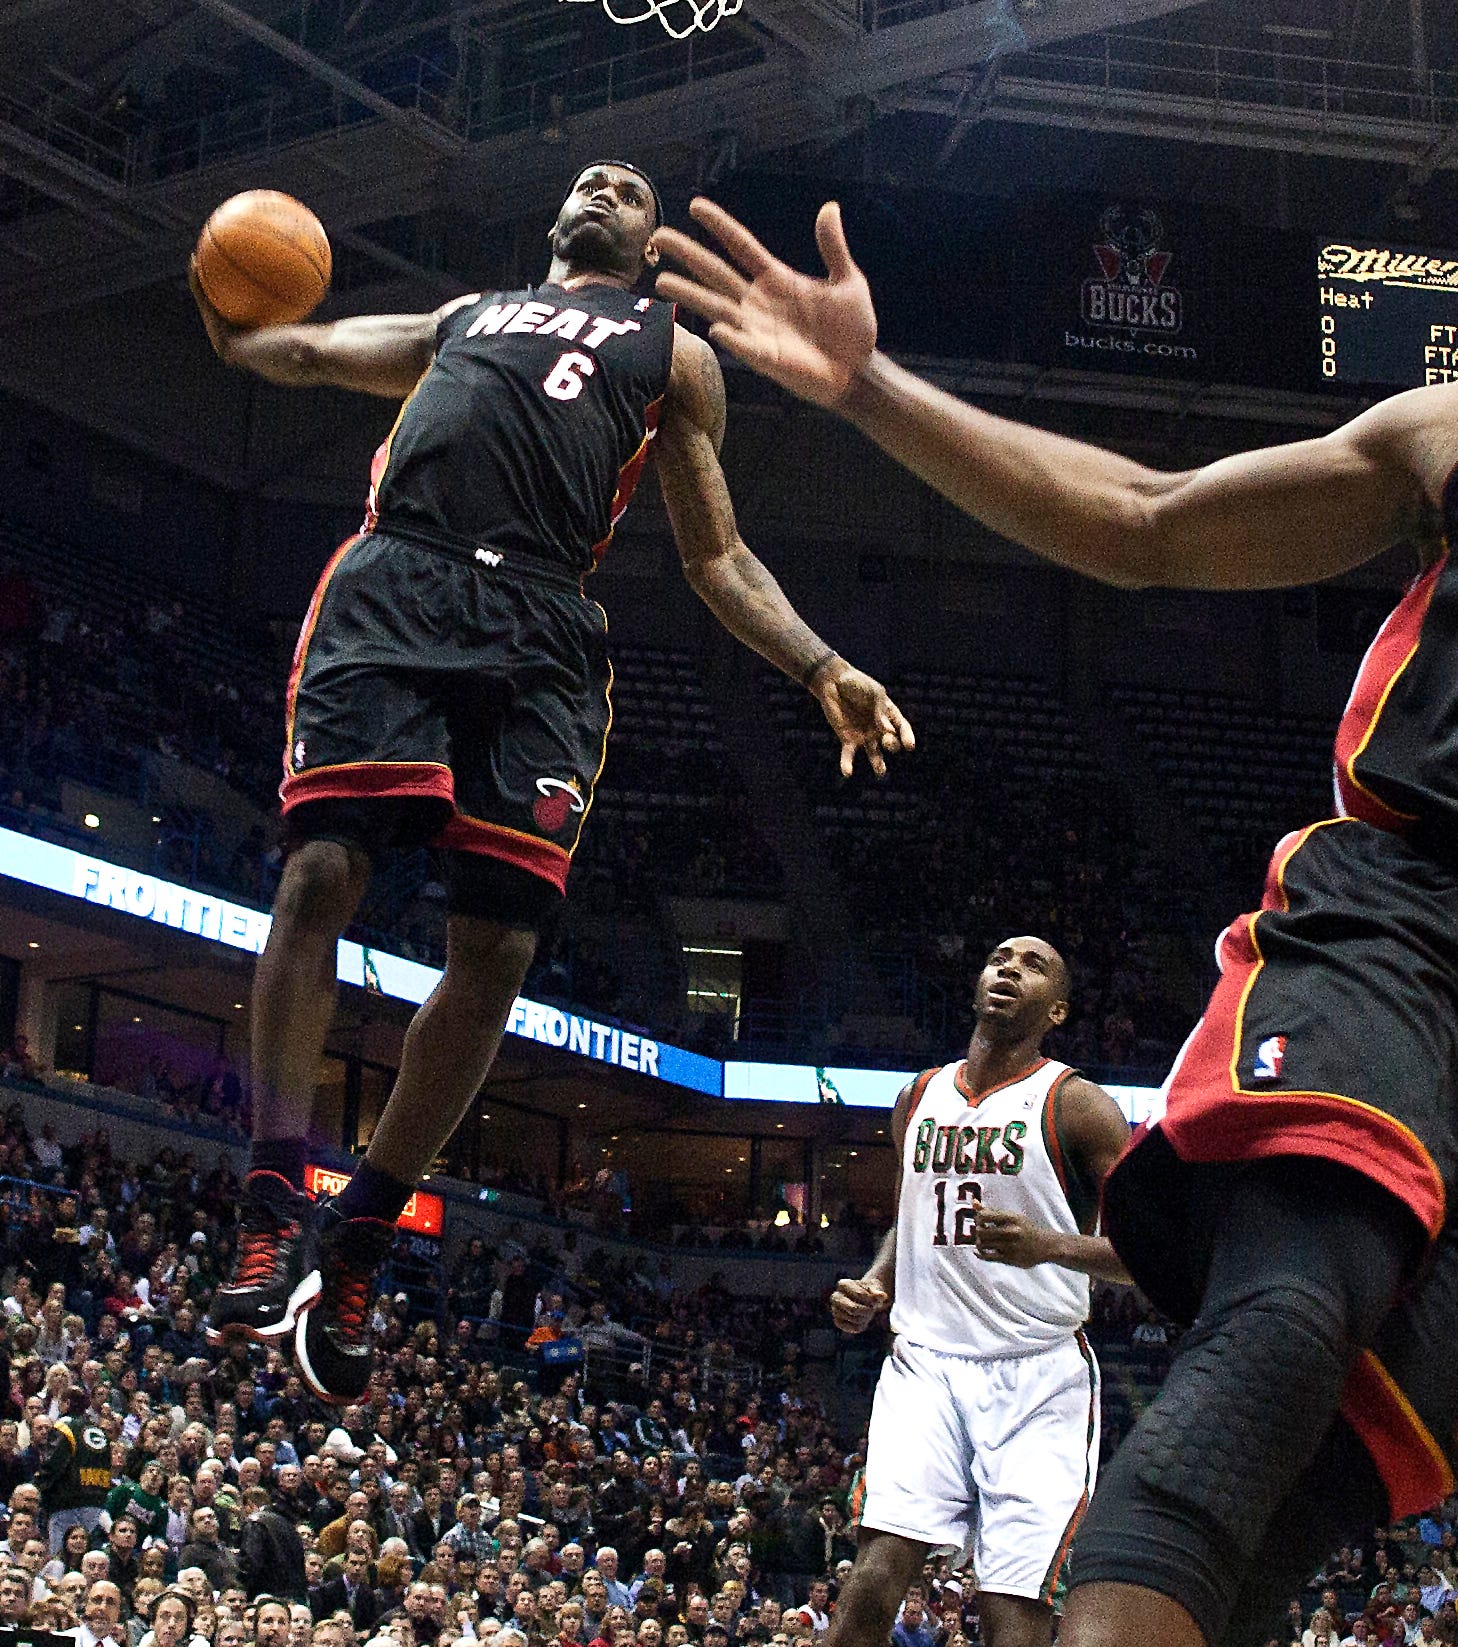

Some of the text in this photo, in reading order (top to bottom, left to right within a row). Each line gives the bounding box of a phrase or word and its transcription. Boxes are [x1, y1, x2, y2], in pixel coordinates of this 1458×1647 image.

[1090, 285, 1176, 328] BUCKS
[1320, 287, 1374, 310] Heat
[466, 301, 642, 350] HEAT
[1064, 331, 1198, 359] bucks.com
[1321, 315, 1335, 334] 0
[1430, 325, 1457, 344] FT
[1322, 337, 1336, 357] 0
[542, 350, 597, 401] 6
[1322, 357, 1336, 377] 0
[506, 997, 659, 1078] FRONTIER
[913, 1116, 1028, 1176] BUCKS
[932, 1180, 983, 1246] 12
